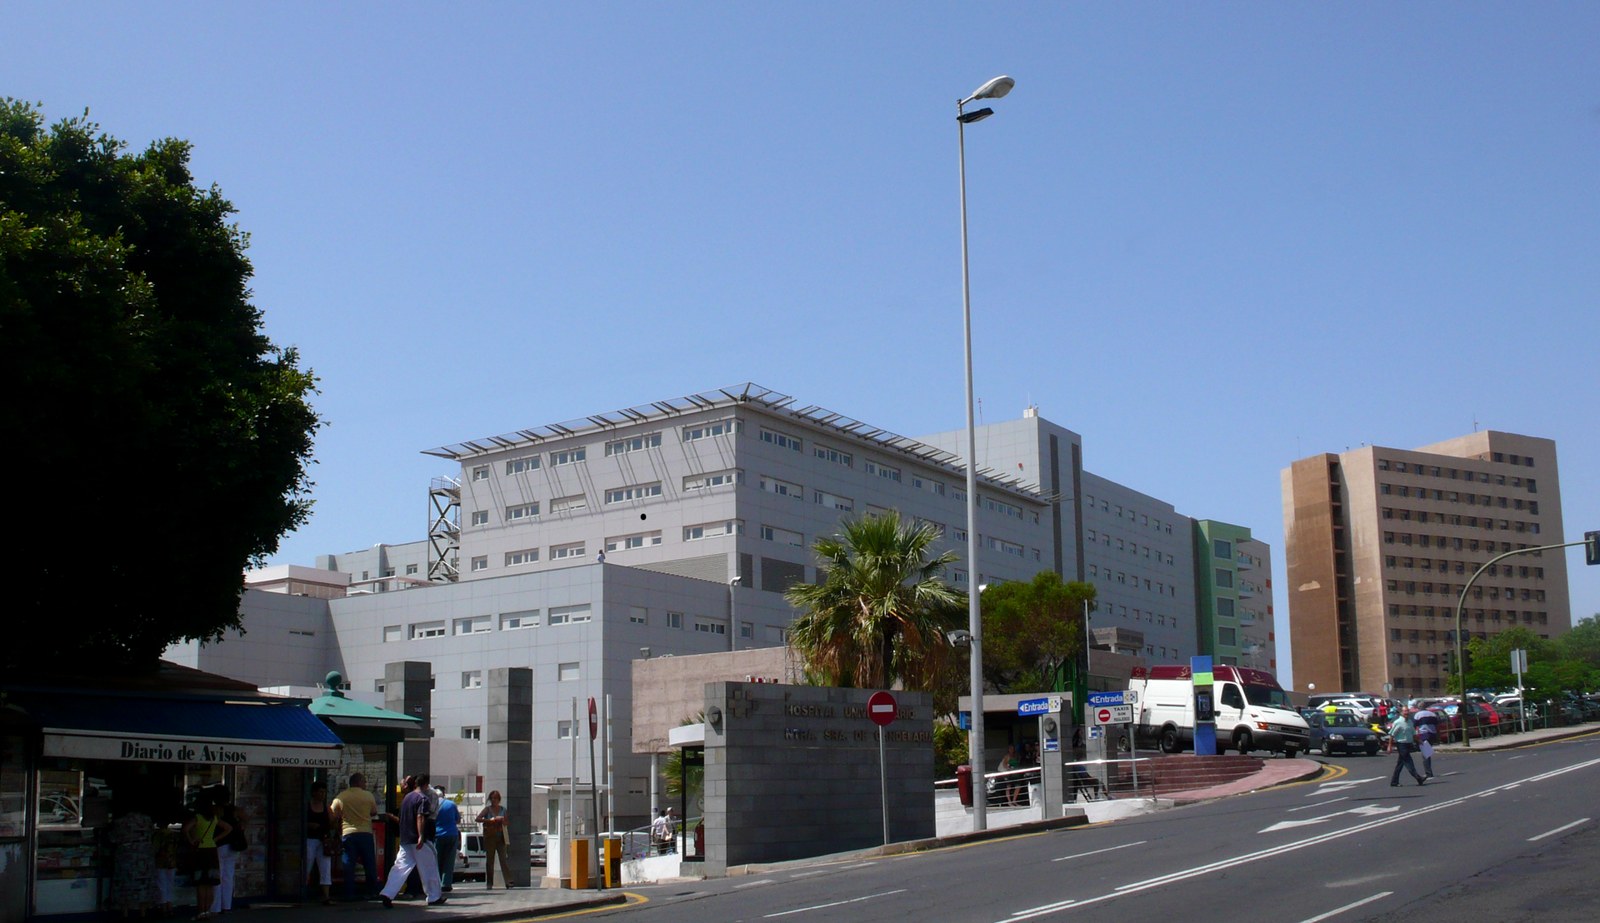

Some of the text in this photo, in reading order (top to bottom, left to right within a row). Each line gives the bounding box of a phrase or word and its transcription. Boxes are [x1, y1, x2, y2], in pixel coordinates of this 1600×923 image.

[1096, 693, 1123, 704] Entrada
[786, 704, 915, 719] HOSPITAL UNIVARIO
[1024, 701, 1048, 712] Entrada
[120, 741, 247, 763] Diario de Avisos
[271, 757, 337, 767] KIOSCO AGUSTIN
